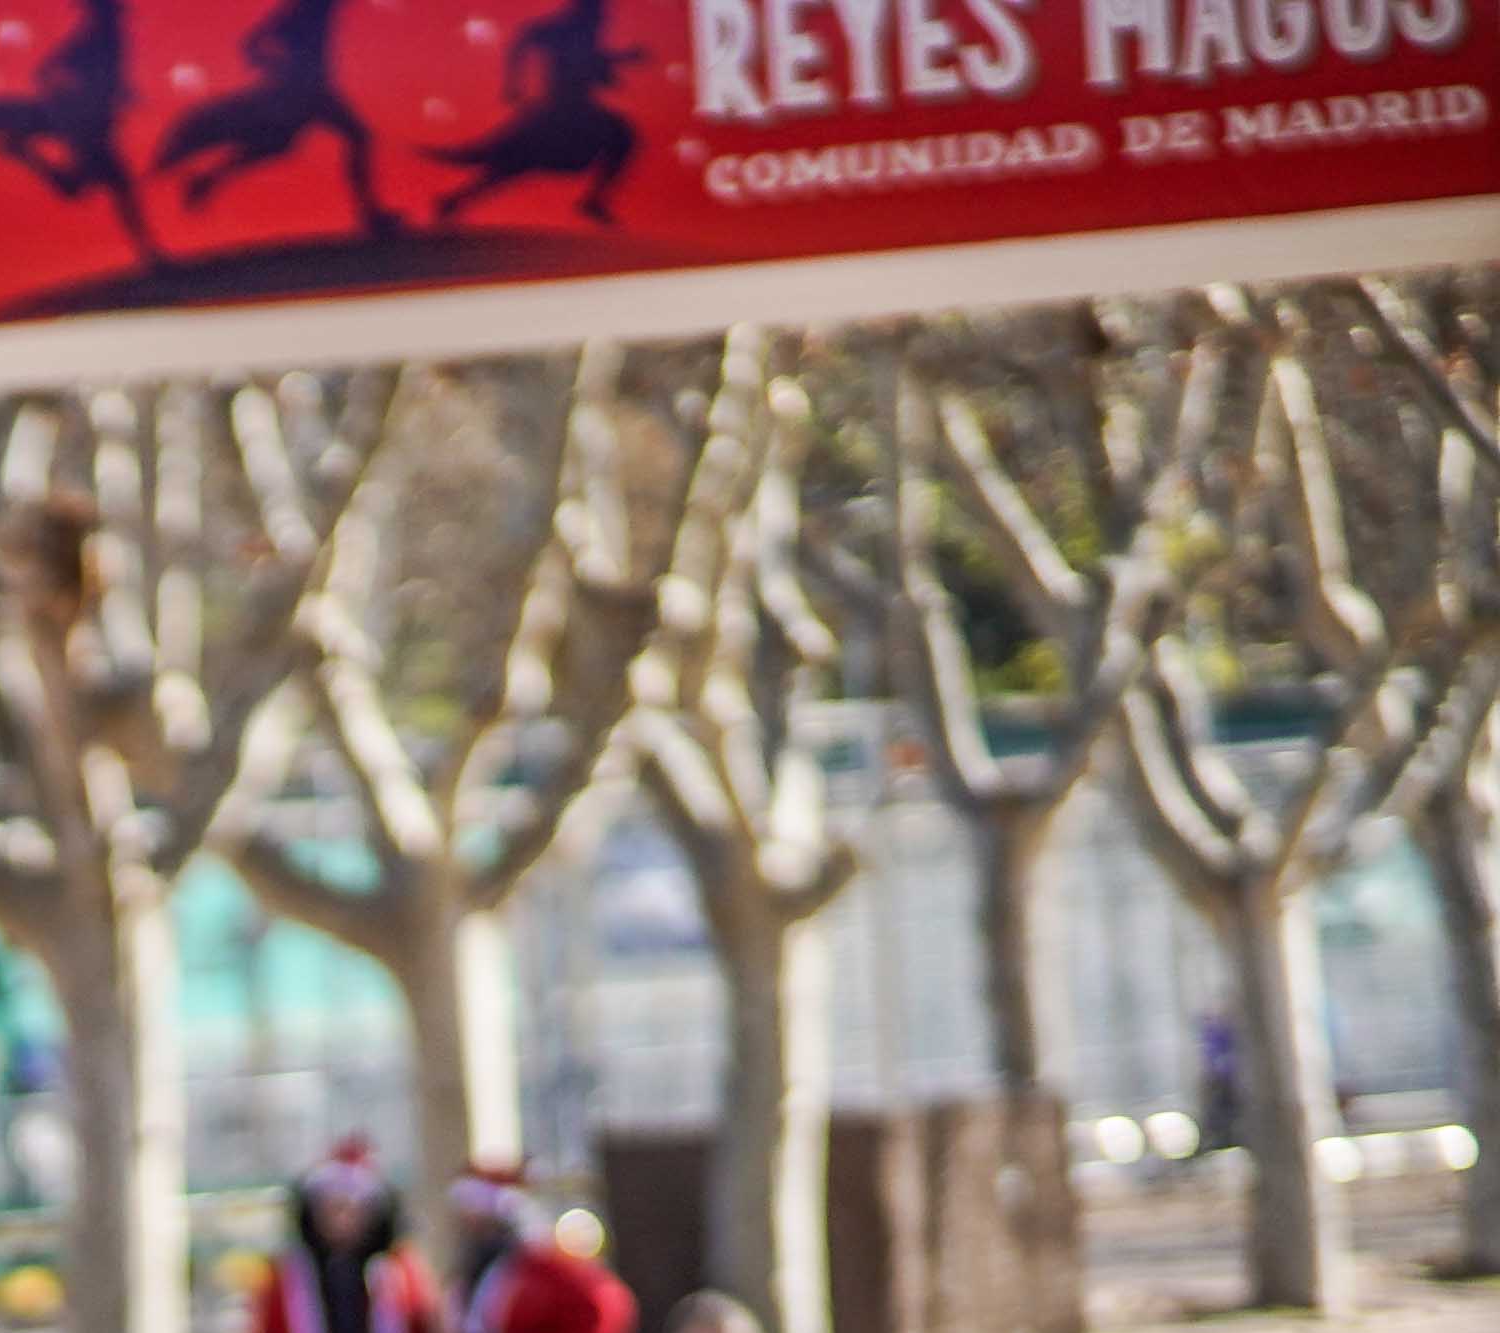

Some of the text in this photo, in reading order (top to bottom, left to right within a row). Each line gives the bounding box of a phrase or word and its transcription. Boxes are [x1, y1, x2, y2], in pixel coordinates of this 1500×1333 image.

[691, 0, 1037, 119] REYES
[705, 85, 1486, 197] COMUNIDAD DE MADRID
